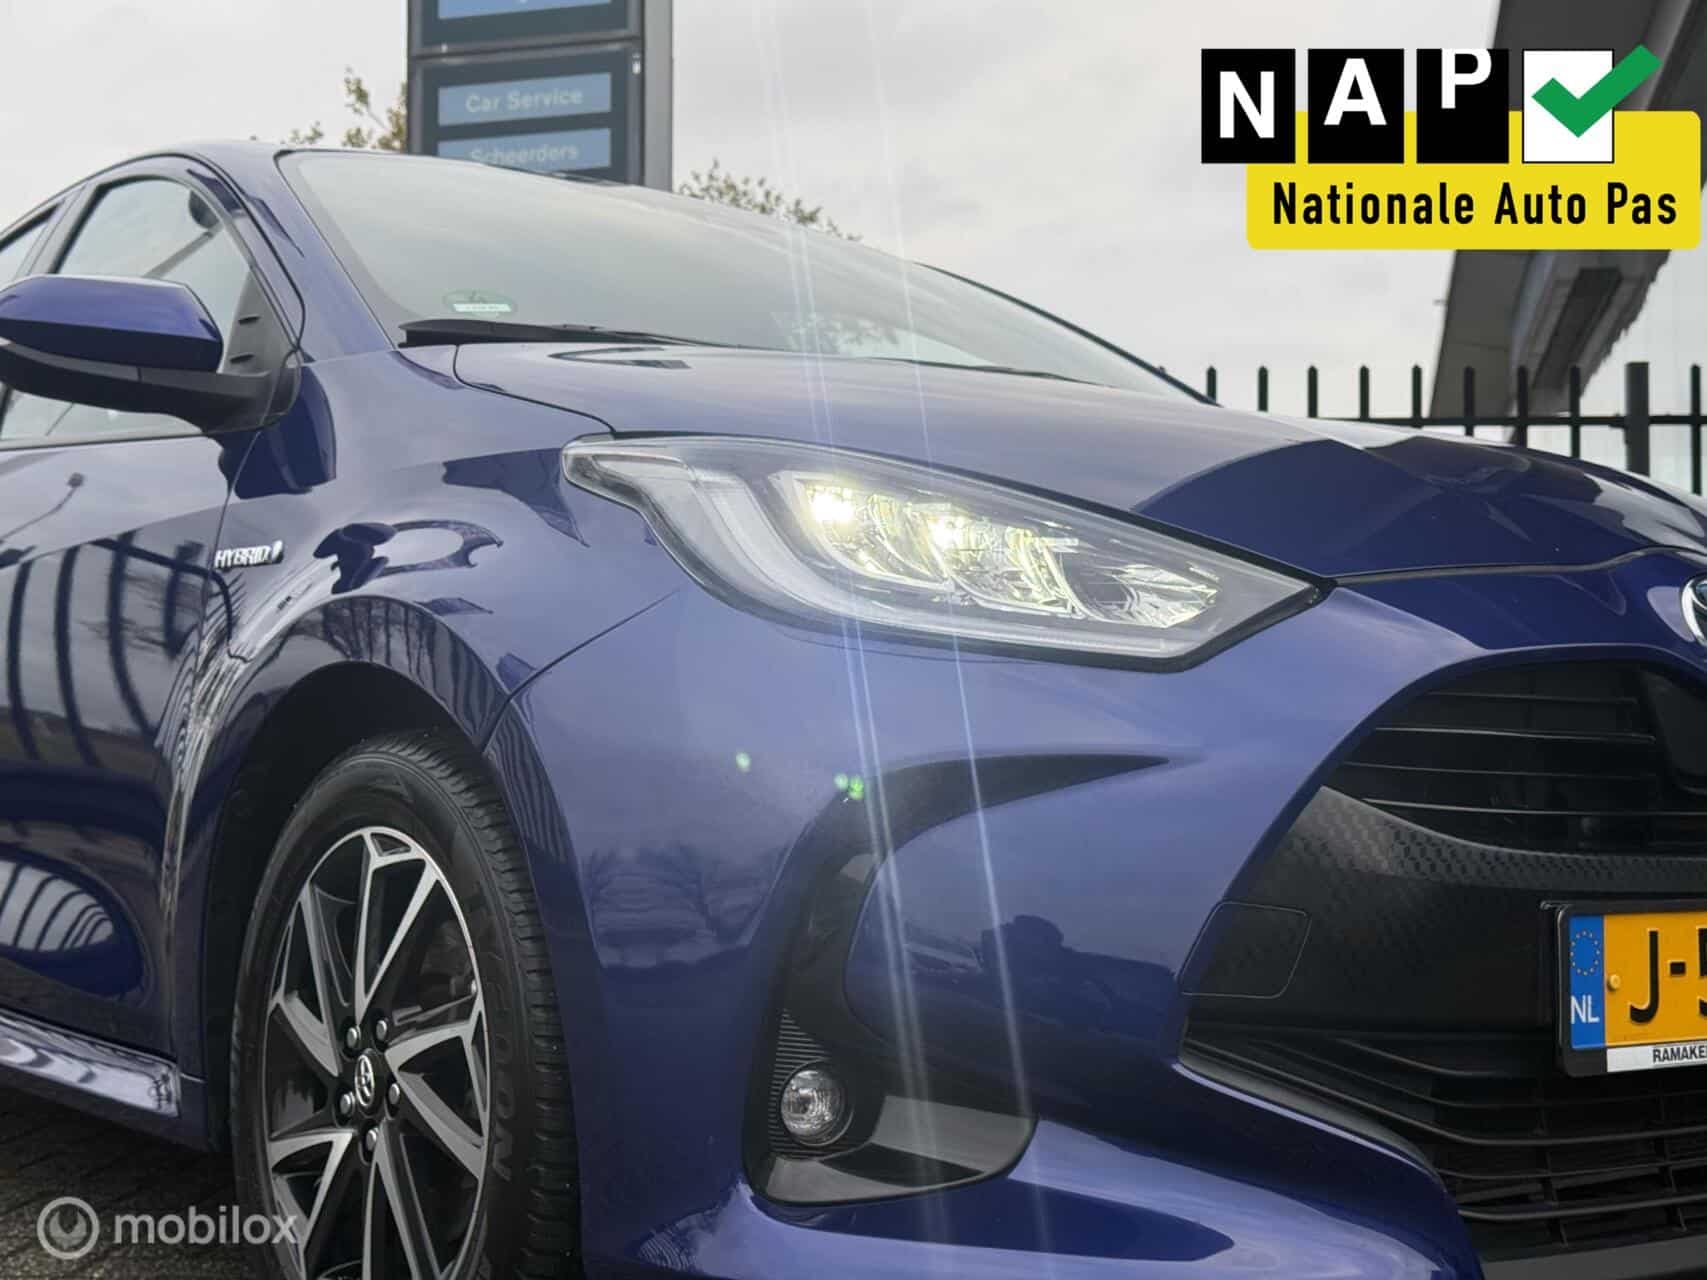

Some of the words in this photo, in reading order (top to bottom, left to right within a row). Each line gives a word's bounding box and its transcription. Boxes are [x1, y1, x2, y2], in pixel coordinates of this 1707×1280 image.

[466, 93, 500, 113] Car
[507, 88, 584, 111] Service
[471, 144, 579, 165] Scheerders
[214, 545, 272, 568] HYBRID
[1570, 994, 1600, 1024] NL
[1652, 1045, 1707, 1063] RAMAKE
